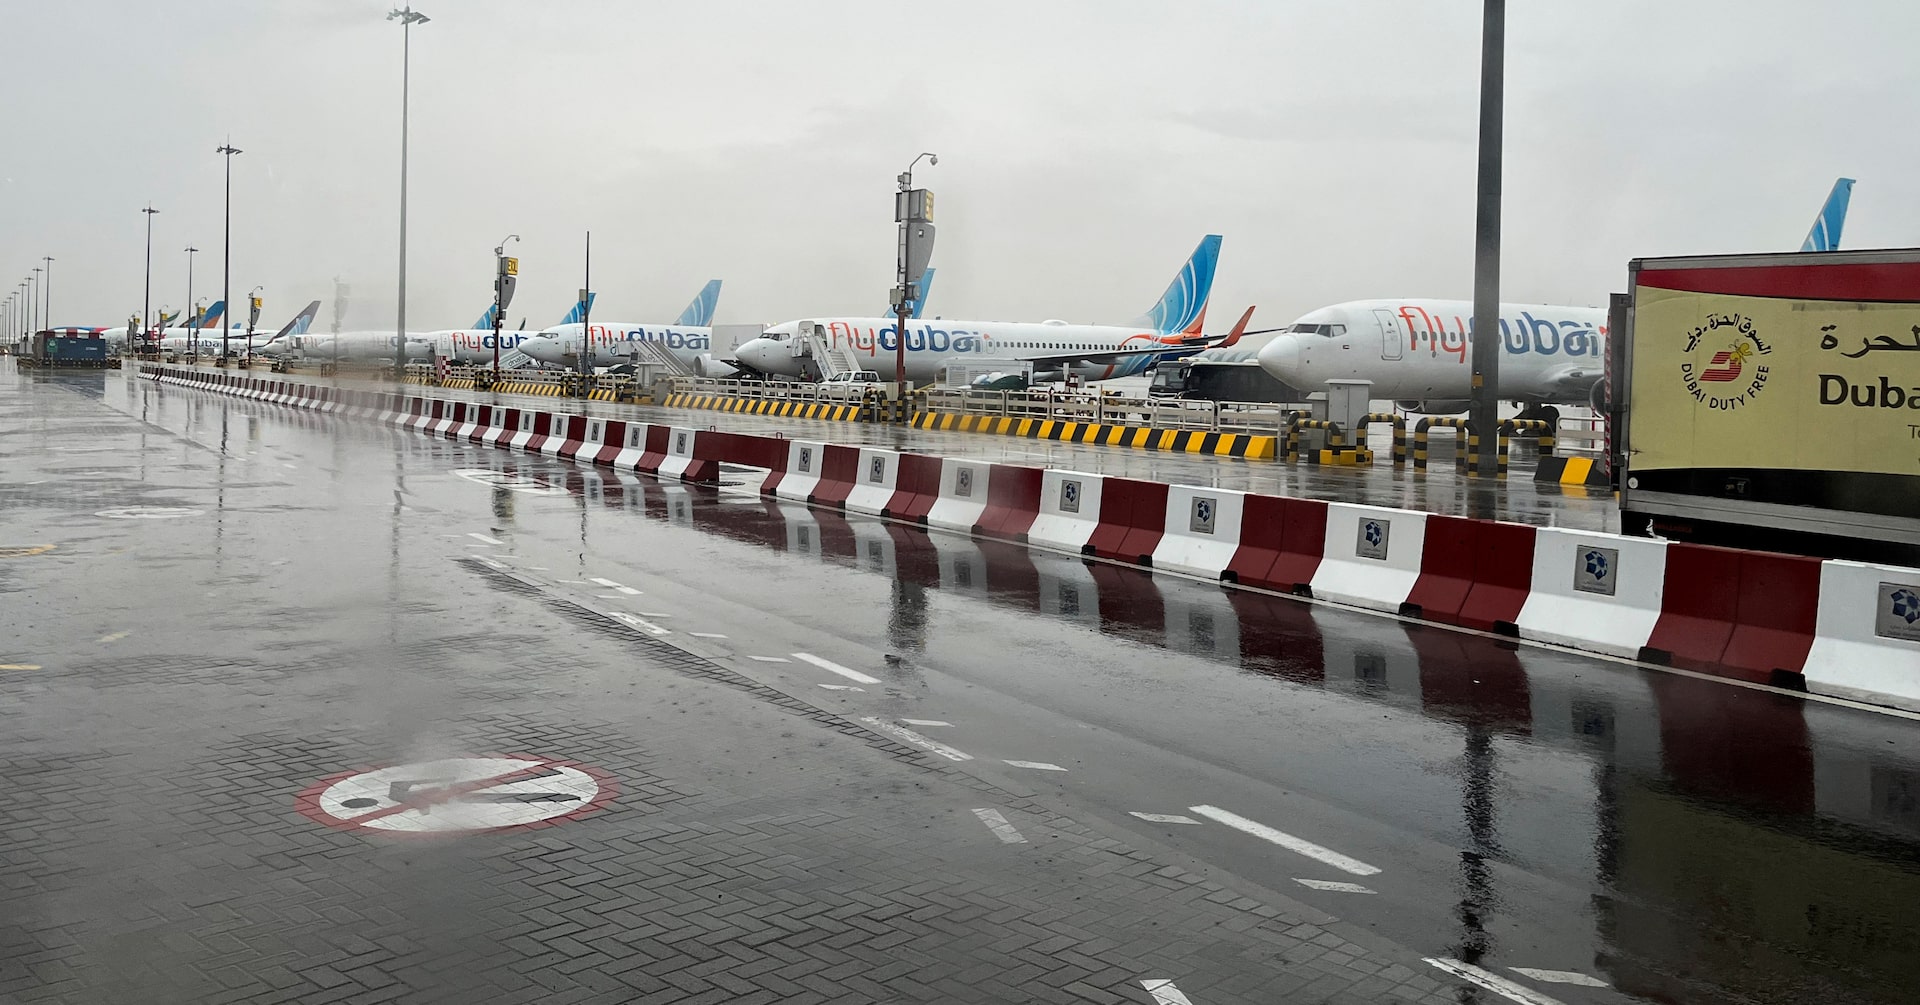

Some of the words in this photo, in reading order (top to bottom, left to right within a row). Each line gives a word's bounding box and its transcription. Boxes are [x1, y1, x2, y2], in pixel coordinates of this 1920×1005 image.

[1398, 306, 1600, 364] flyubai
[1739, 317, 1772, 355] السوق
[1681, 363, 1706, 403] DUBAI
[1709, 394, 1744, 410] DUTY
[1746, 365, 1769, 398] FREE
